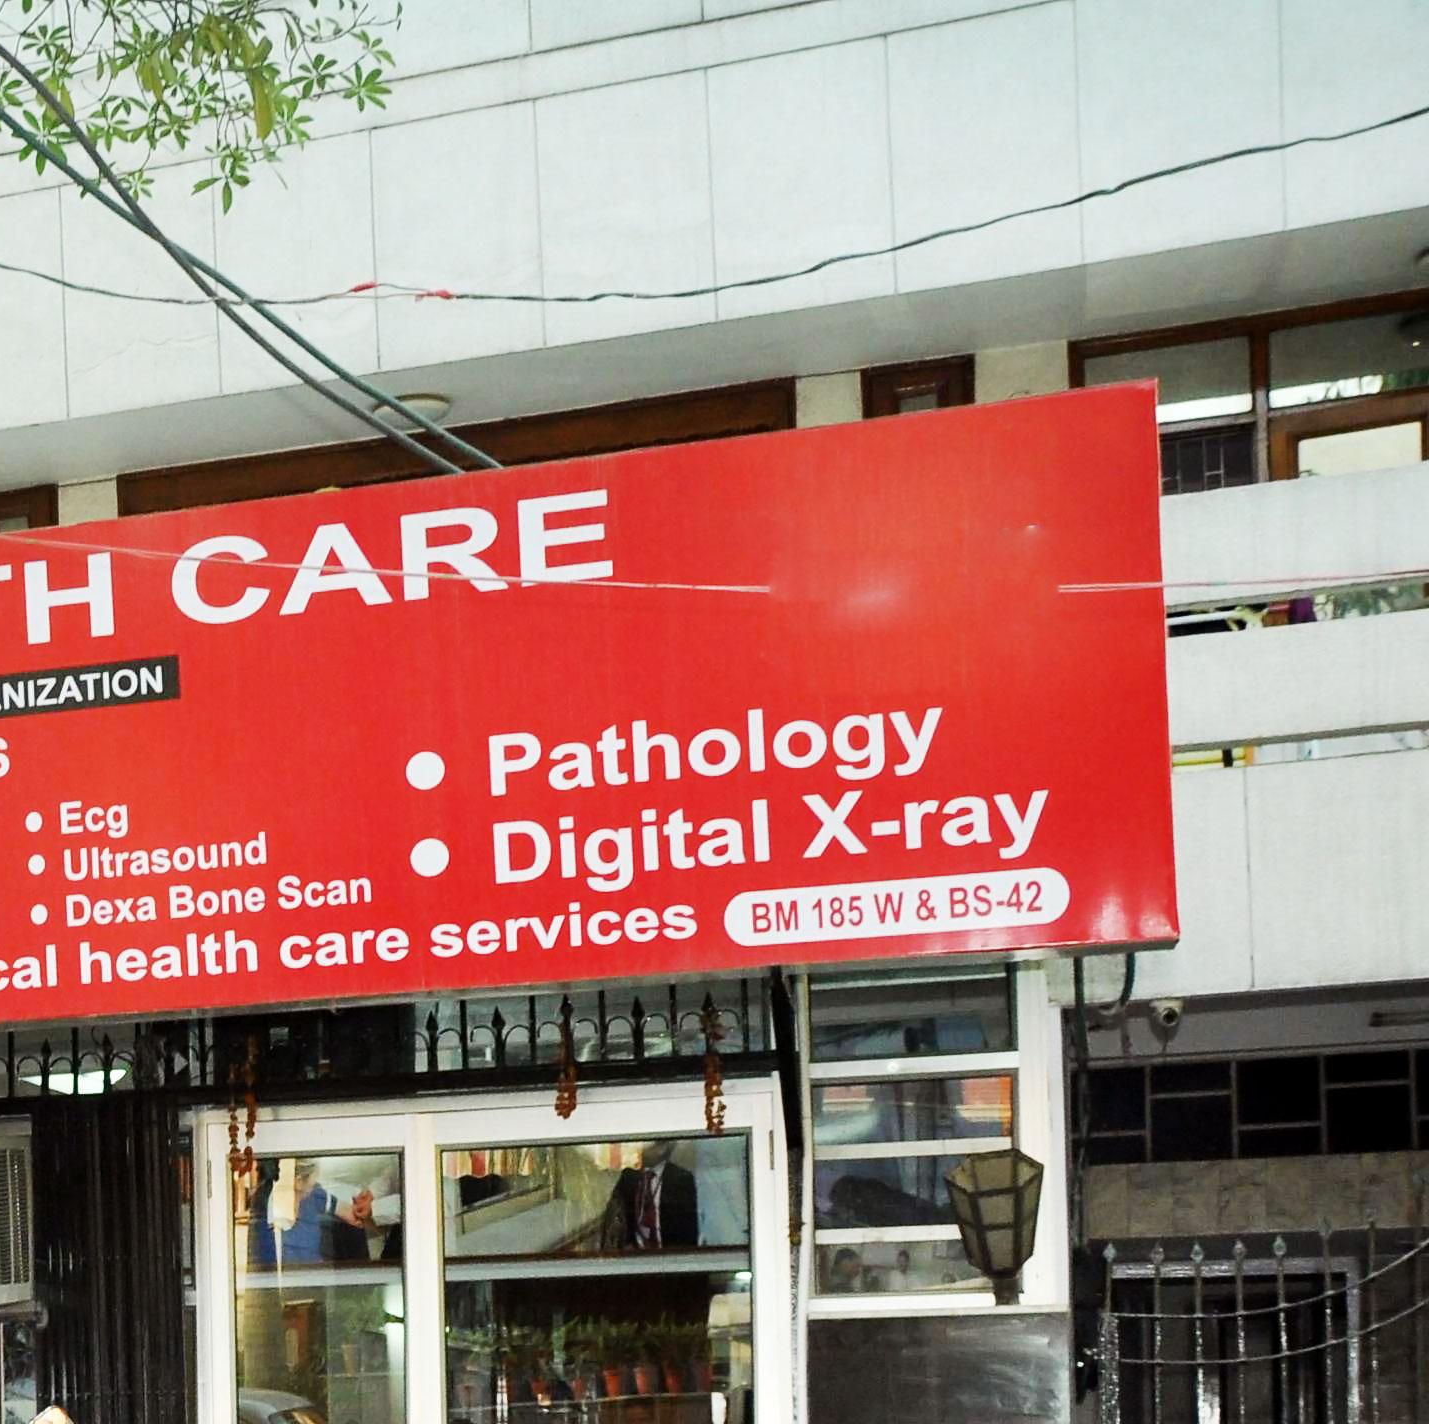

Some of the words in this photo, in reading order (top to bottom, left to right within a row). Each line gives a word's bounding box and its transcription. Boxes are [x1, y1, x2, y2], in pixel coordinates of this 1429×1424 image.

[170, 489, 614, 627] CARE
[488, 706, 943, 799] Pathology
[59, 800, 131, 843] Ecg
[63, 833, 269, 881] Ultrasound
[492, 794, 771, 893] Digital
[802, 790, 1050, 866] X-ray
[65, 887, 156, 930] Dexa
[167, 878, 266, 923] Bone
[277, 871, 372, 912] Scan
[79, 928, 259, 986] health
[279, 930, 410, 969] care
[430, 899, 698, 958] services
[750, 902, 800, 934] BM
[812, 893, 865, 930] 185
[875, 892, 907, 925] W
[915, 888, 939, 922] &
[948, 880, 1044, 919] BS-42
